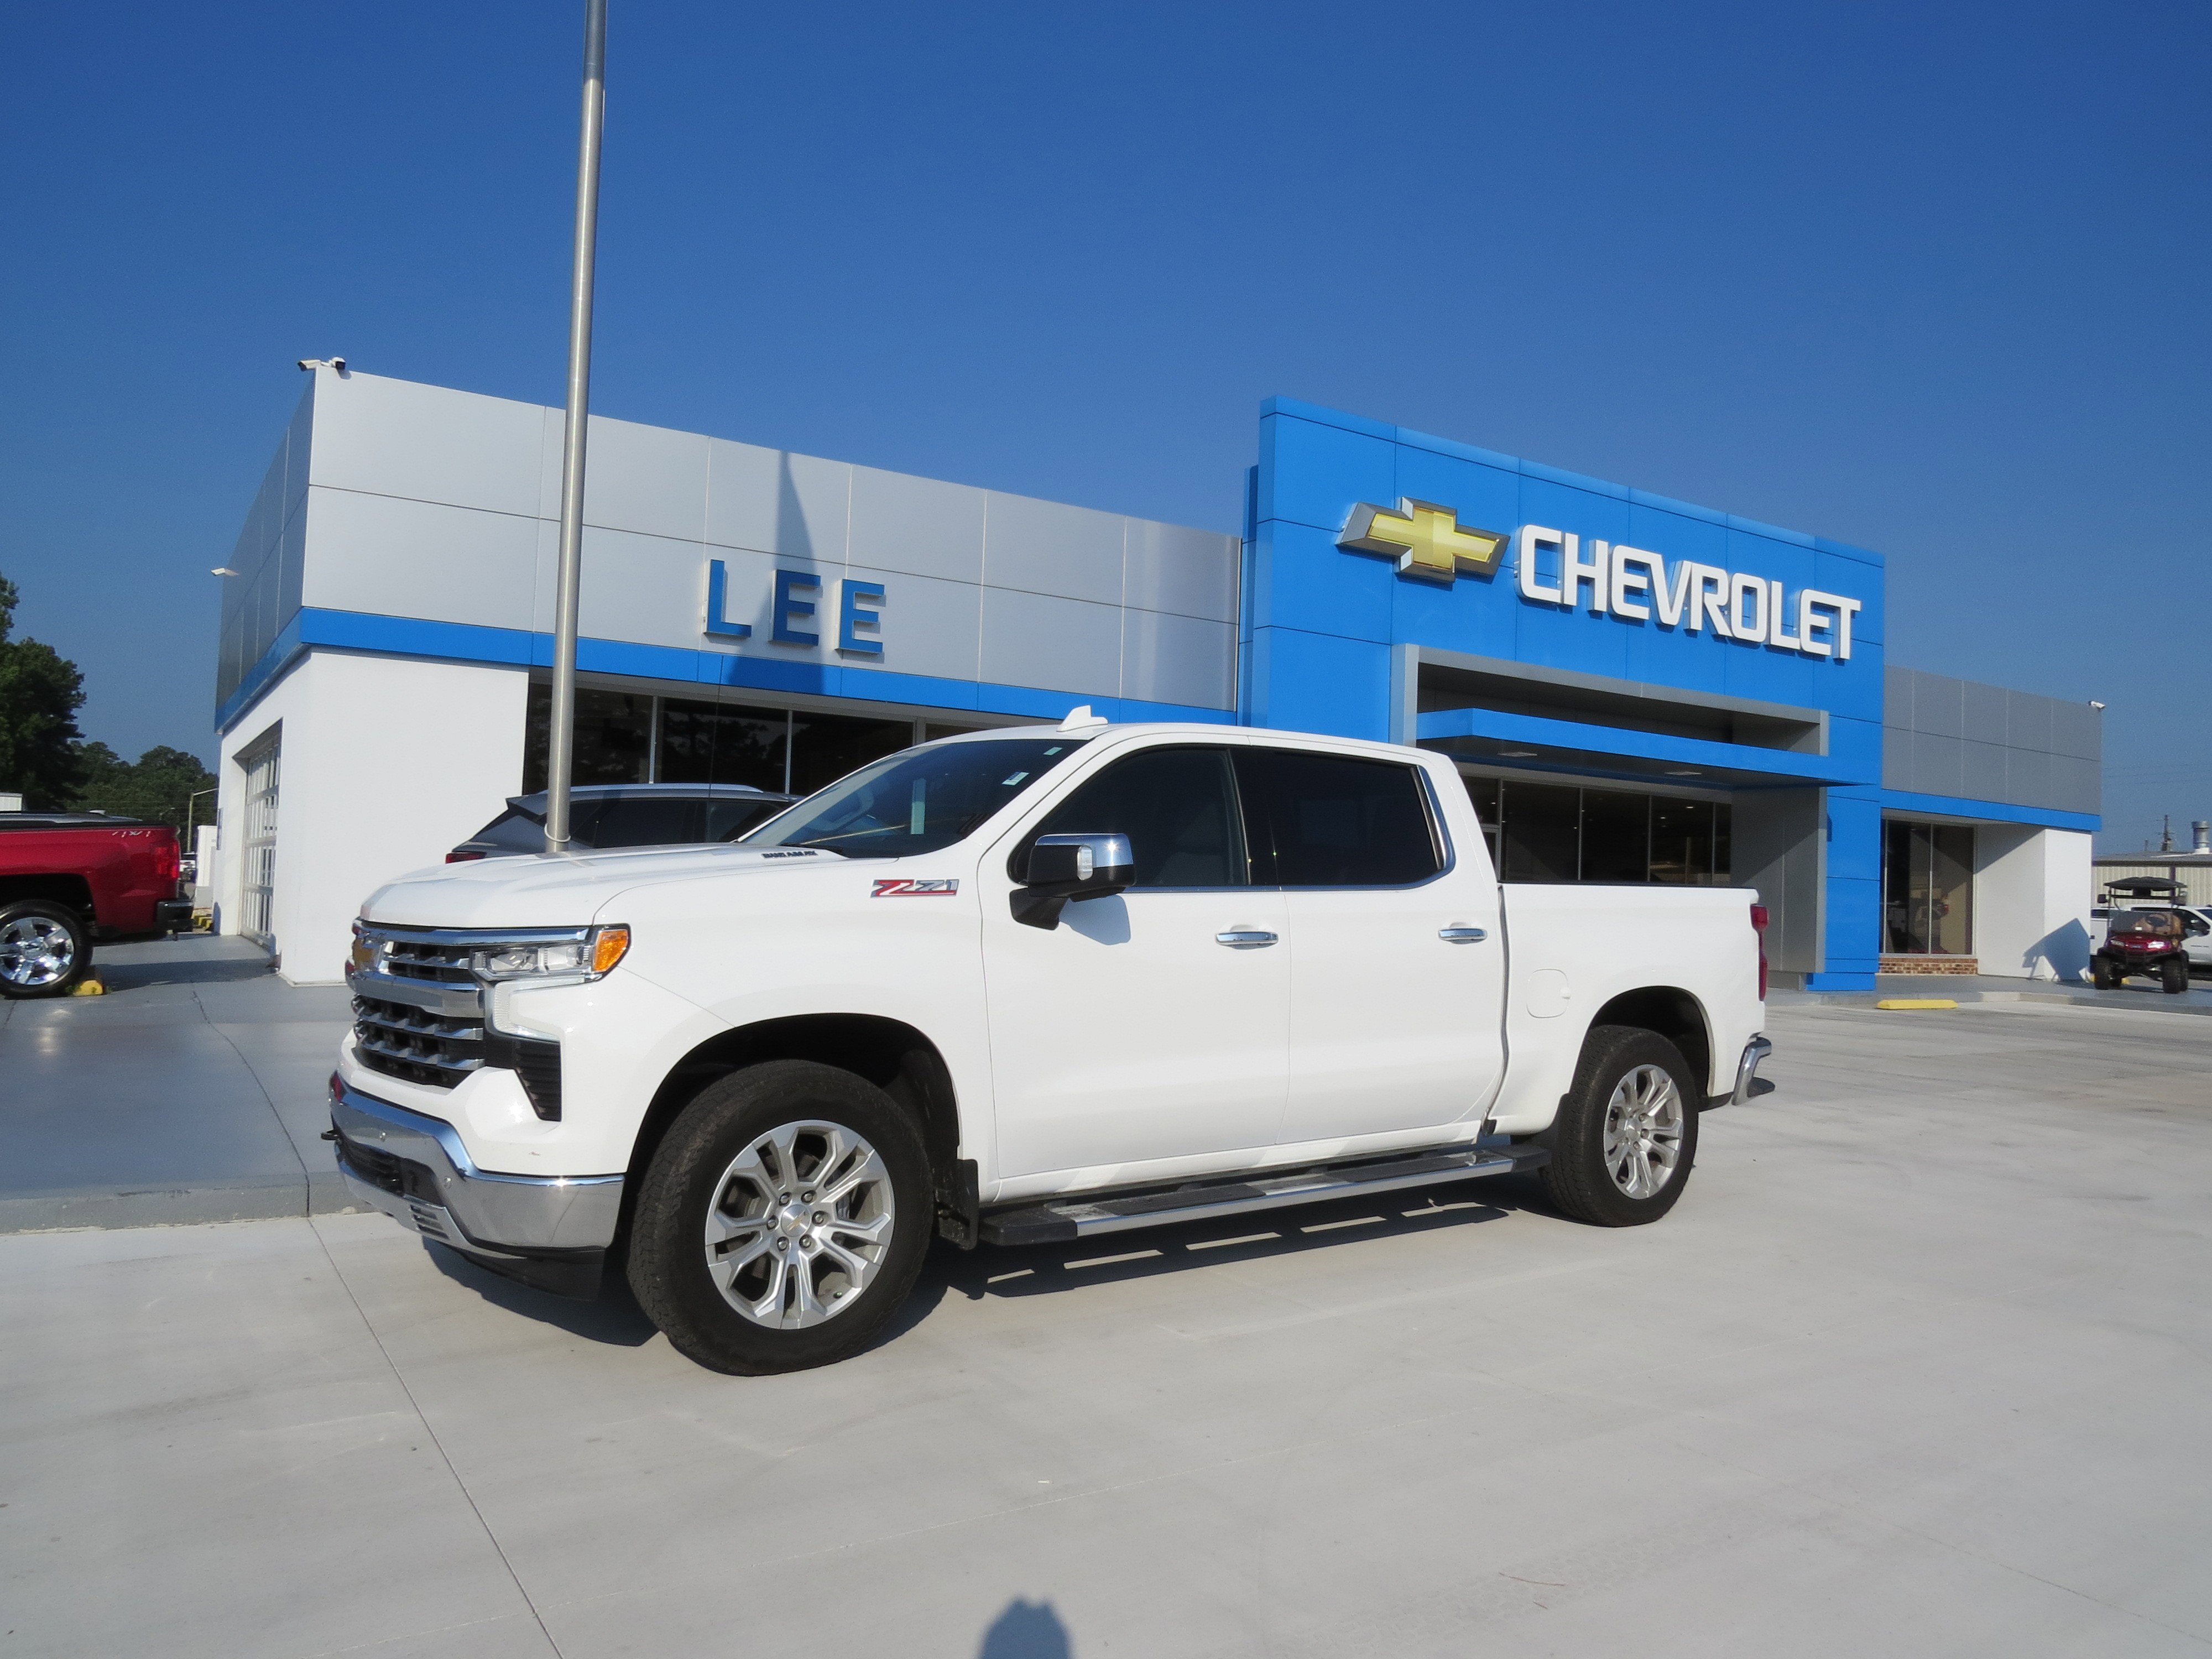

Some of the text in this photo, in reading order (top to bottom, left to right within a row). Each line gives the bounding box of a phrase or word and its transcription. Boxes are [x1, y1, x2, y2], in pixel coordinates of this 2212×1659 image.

[702, 559, 886, 654] LEE
[1514, 524, 1862, 660] CHEVROLET
[870, 879, 959, 898] Z71
